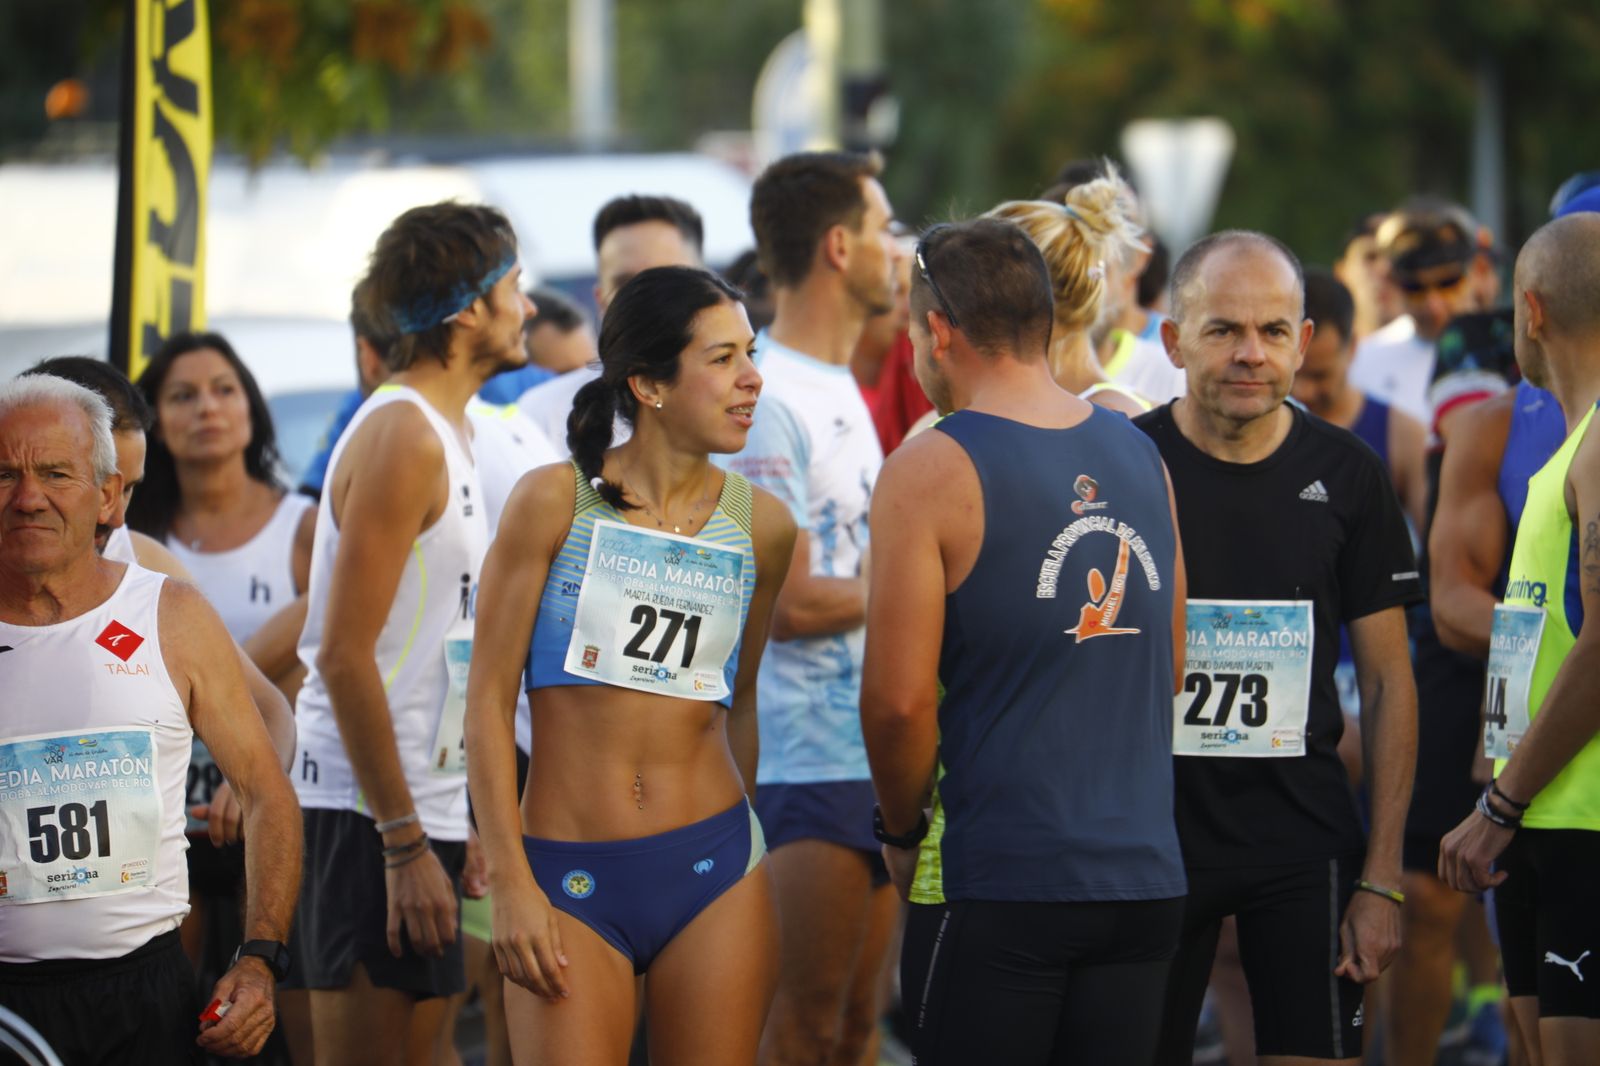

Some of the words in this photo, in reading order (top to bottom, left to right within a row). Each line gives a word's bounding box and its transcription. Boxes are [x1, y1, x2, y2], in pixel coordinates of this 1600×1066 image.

[597, 552, 657, 580] MEDIA
[1036, 550, 1069, 598] ESCUELA
[624, 588, 650, 602] MARTA
[652, 593, 675, 607] RUEDA
[623, 604, 702, 669] 271
[1216, 627, 1307, 647] MARATÓN
[104, 663, 150, 676] TALAI
[632, 663, 678, 681] serizona
[1184, 672, 1269, 728] 273
[51, 752, 149, 782] MARATÓN
[27, 799, 111, 864] 581
[47, 868, 99, 883] serizona
